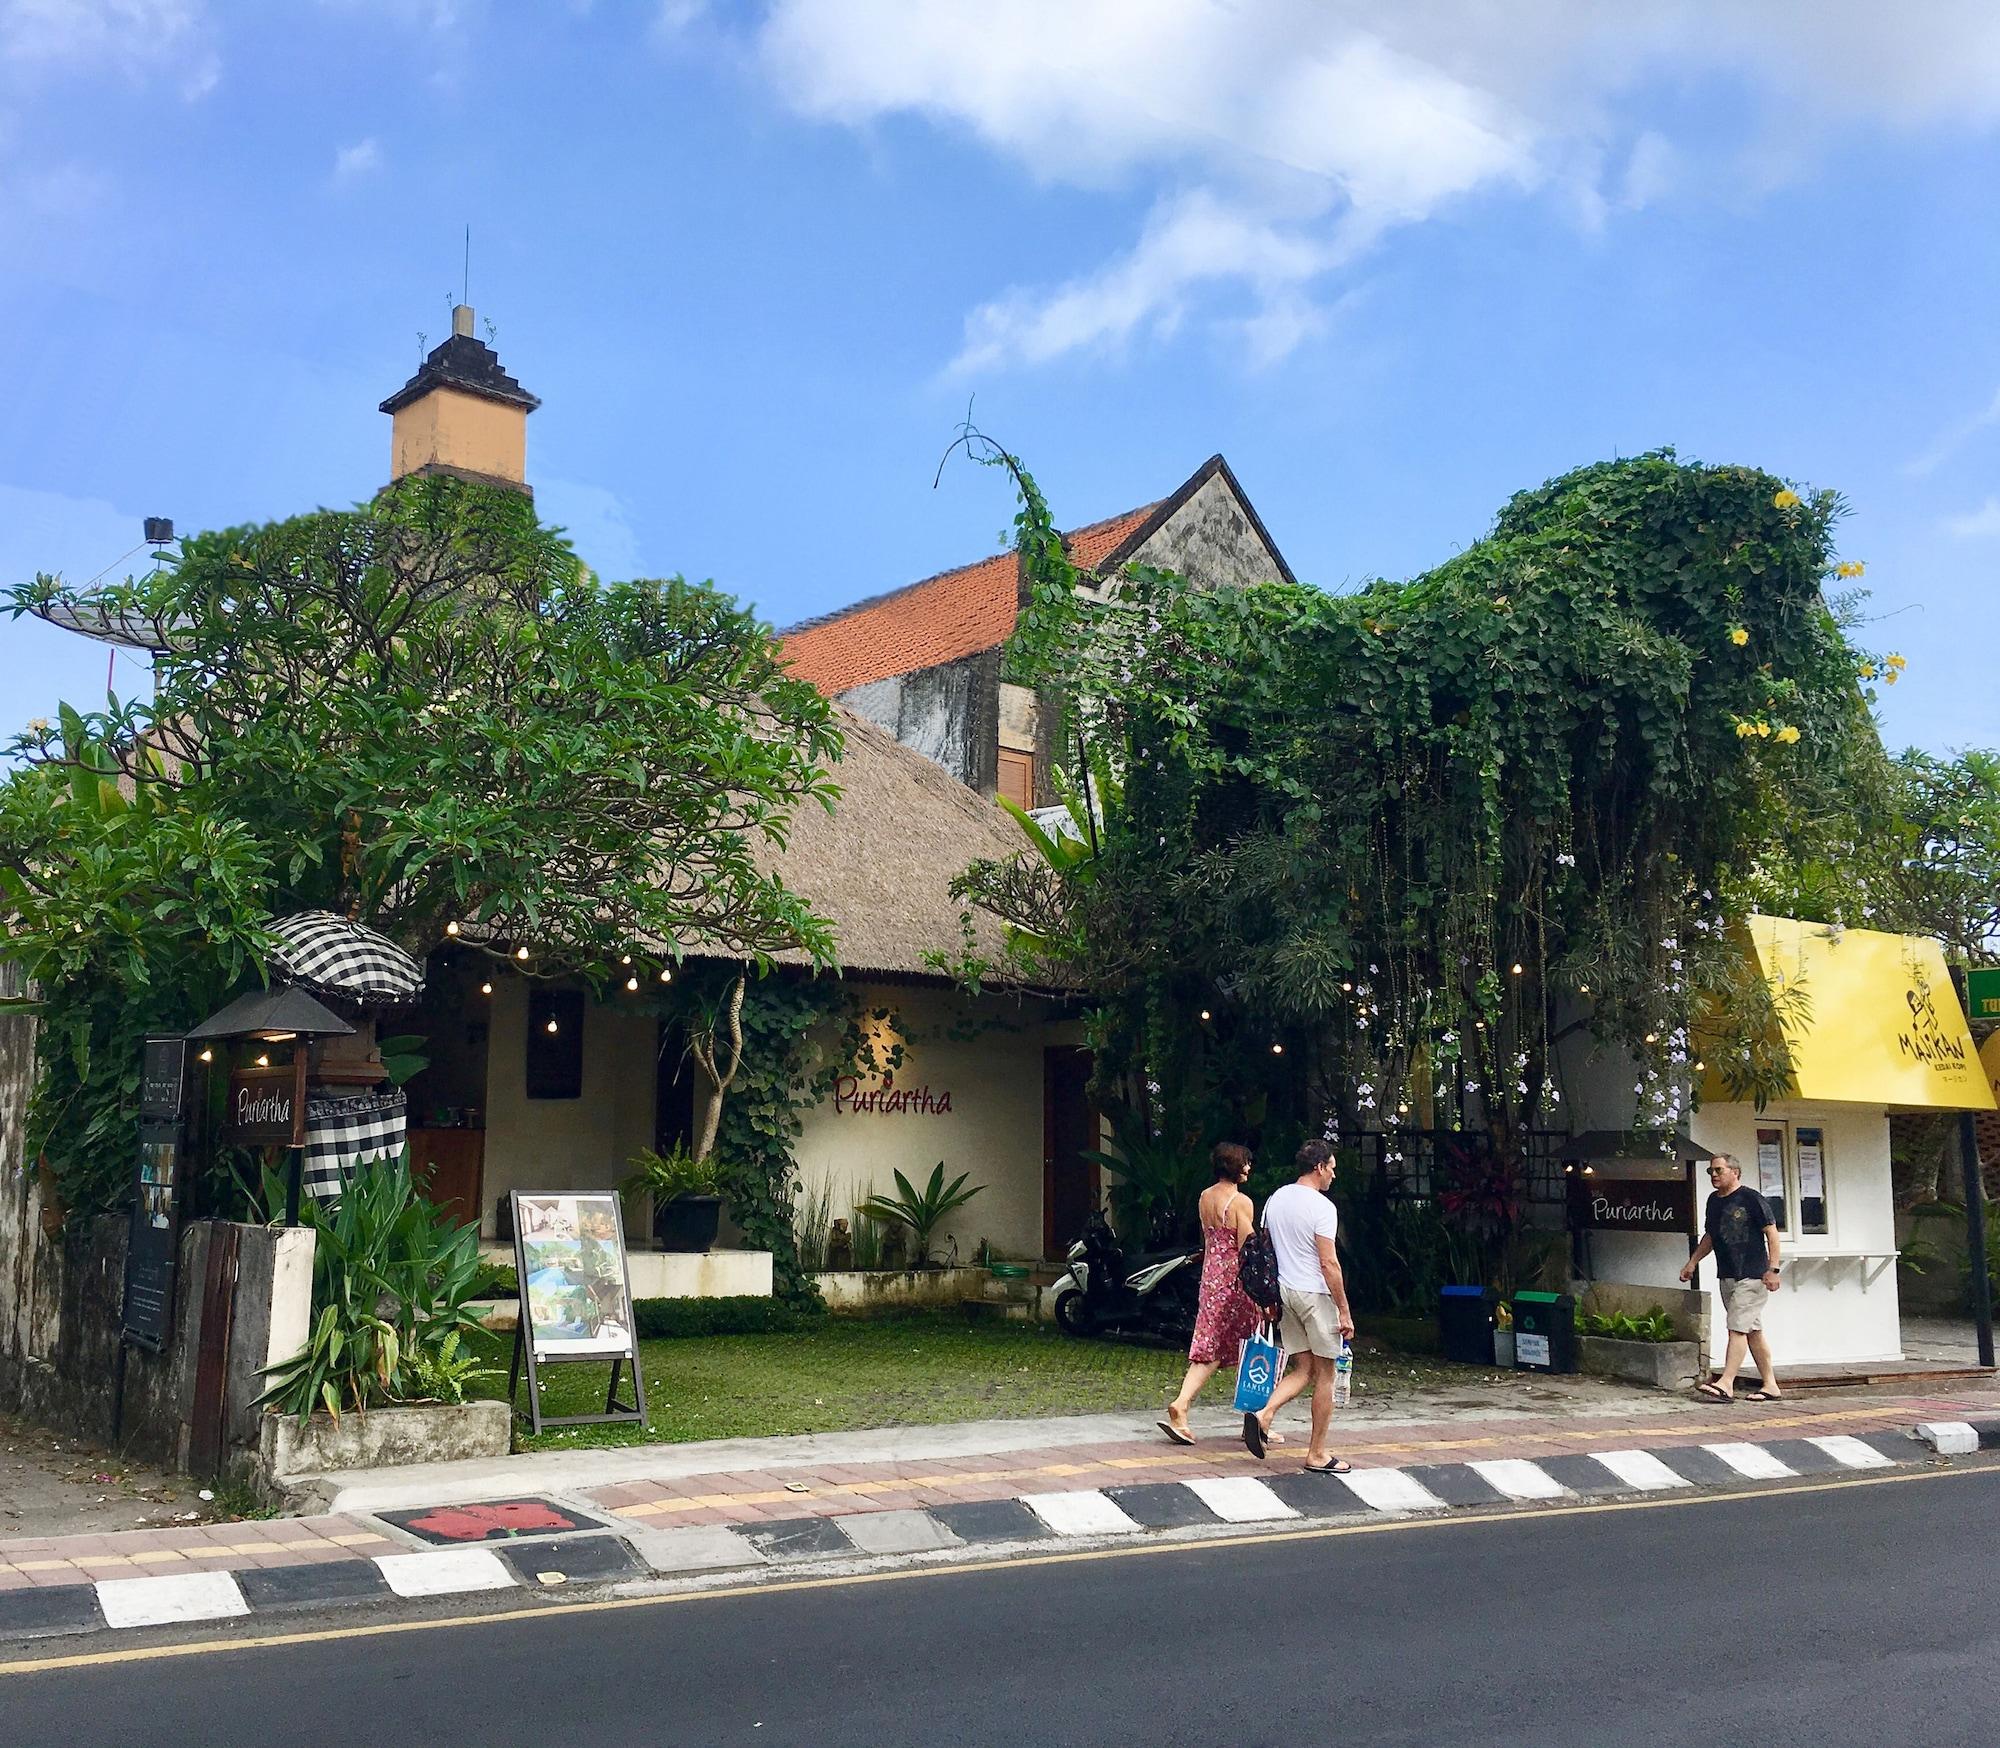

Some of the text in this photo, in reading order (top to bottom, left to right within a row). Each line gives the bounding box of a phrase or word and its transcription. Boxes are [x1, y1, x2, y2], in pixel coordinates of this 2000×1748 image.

[237, 1087, 290, 1126] Puriartha
[833, 1075, 952, 1115] Puriartha
[1592, 1198, 1674, 1220] Puriartha
